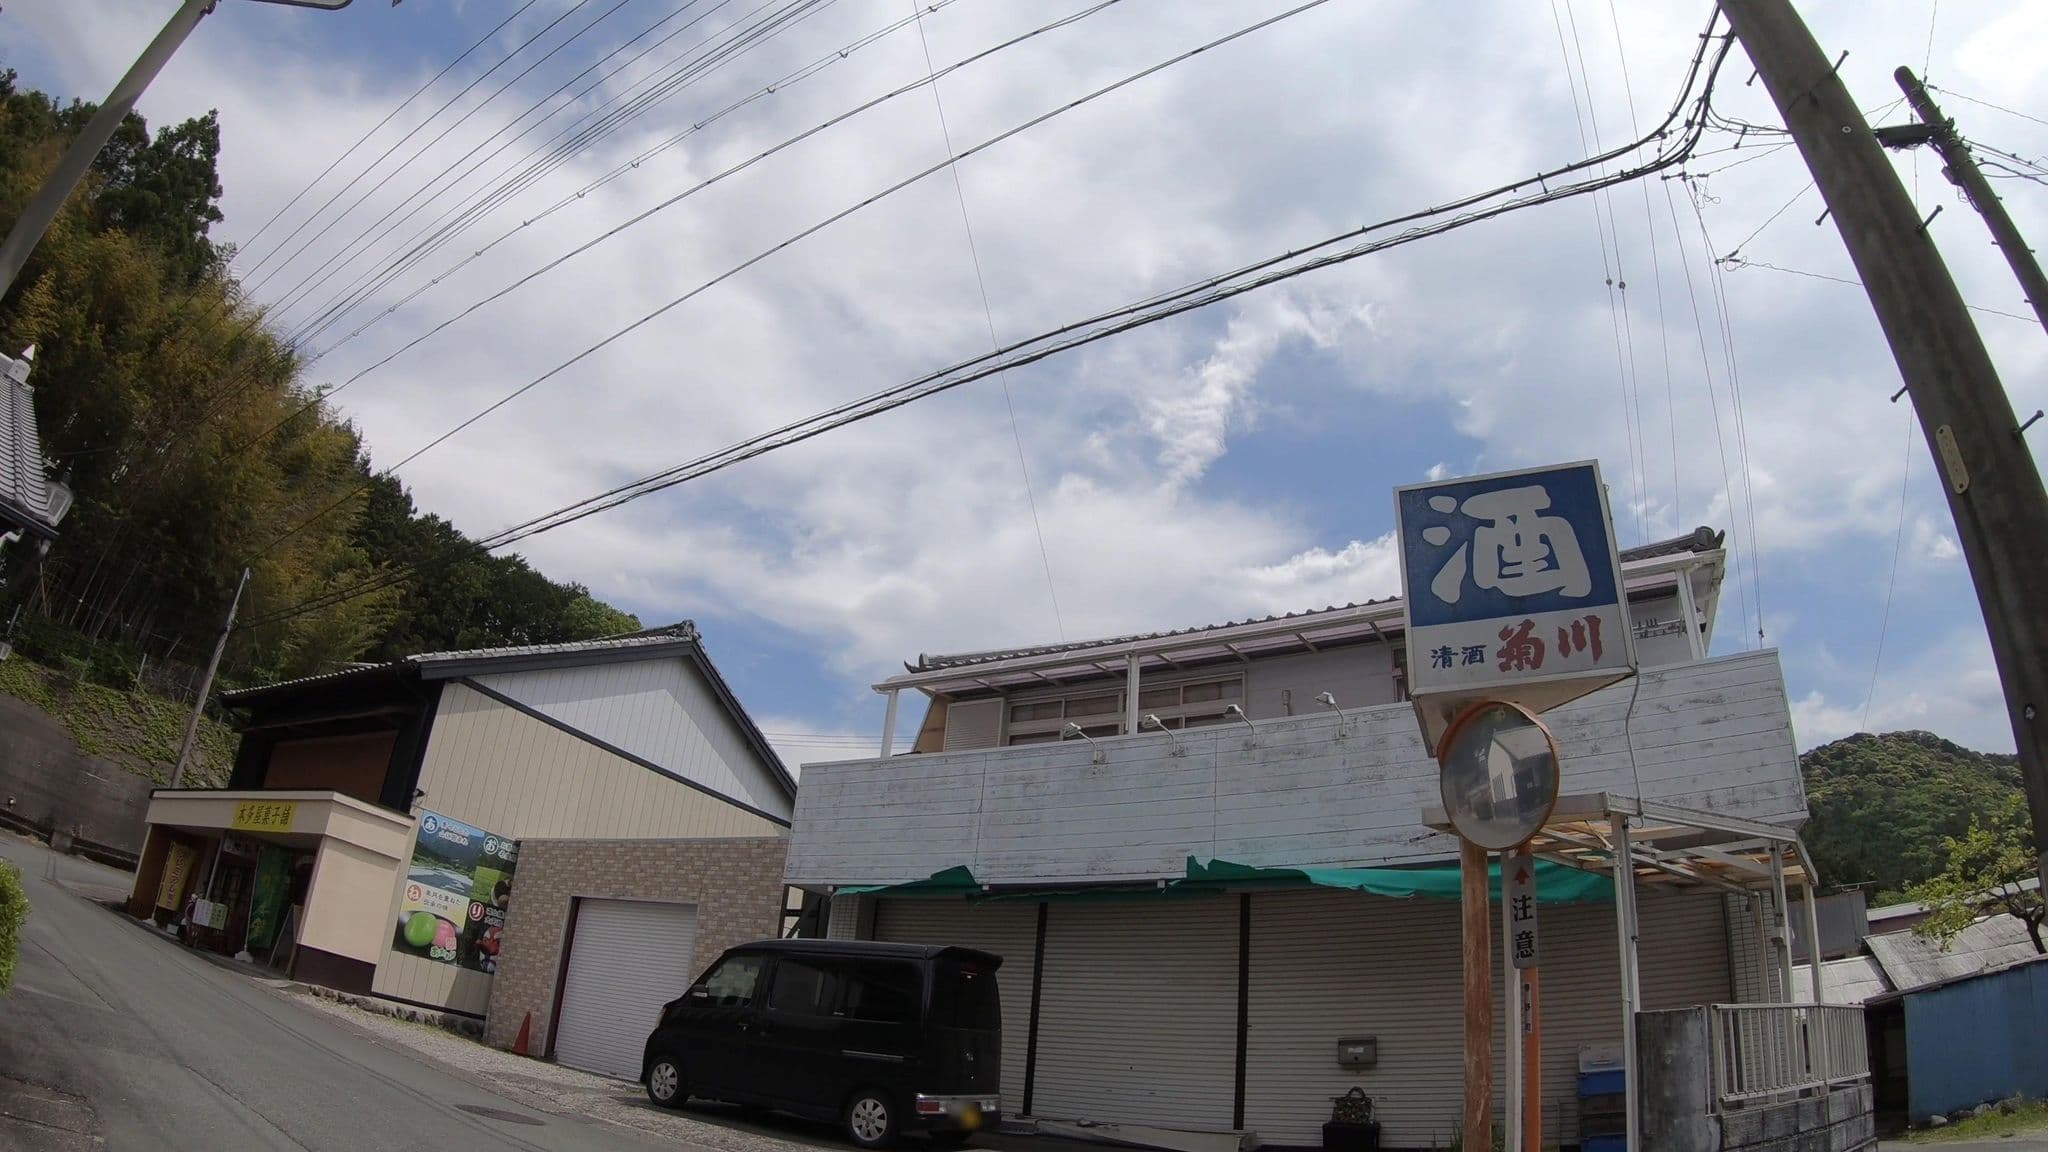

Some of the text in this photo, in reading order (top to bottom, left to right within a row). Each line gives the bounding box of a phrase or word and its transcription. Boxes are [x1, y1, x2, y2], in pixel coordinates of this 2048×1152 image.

[1422, 484, 1592, 604] 酒
[1430, 614, 1604, 673] 清酒 菊川
[1512, 893, 1535, 959] 注意
